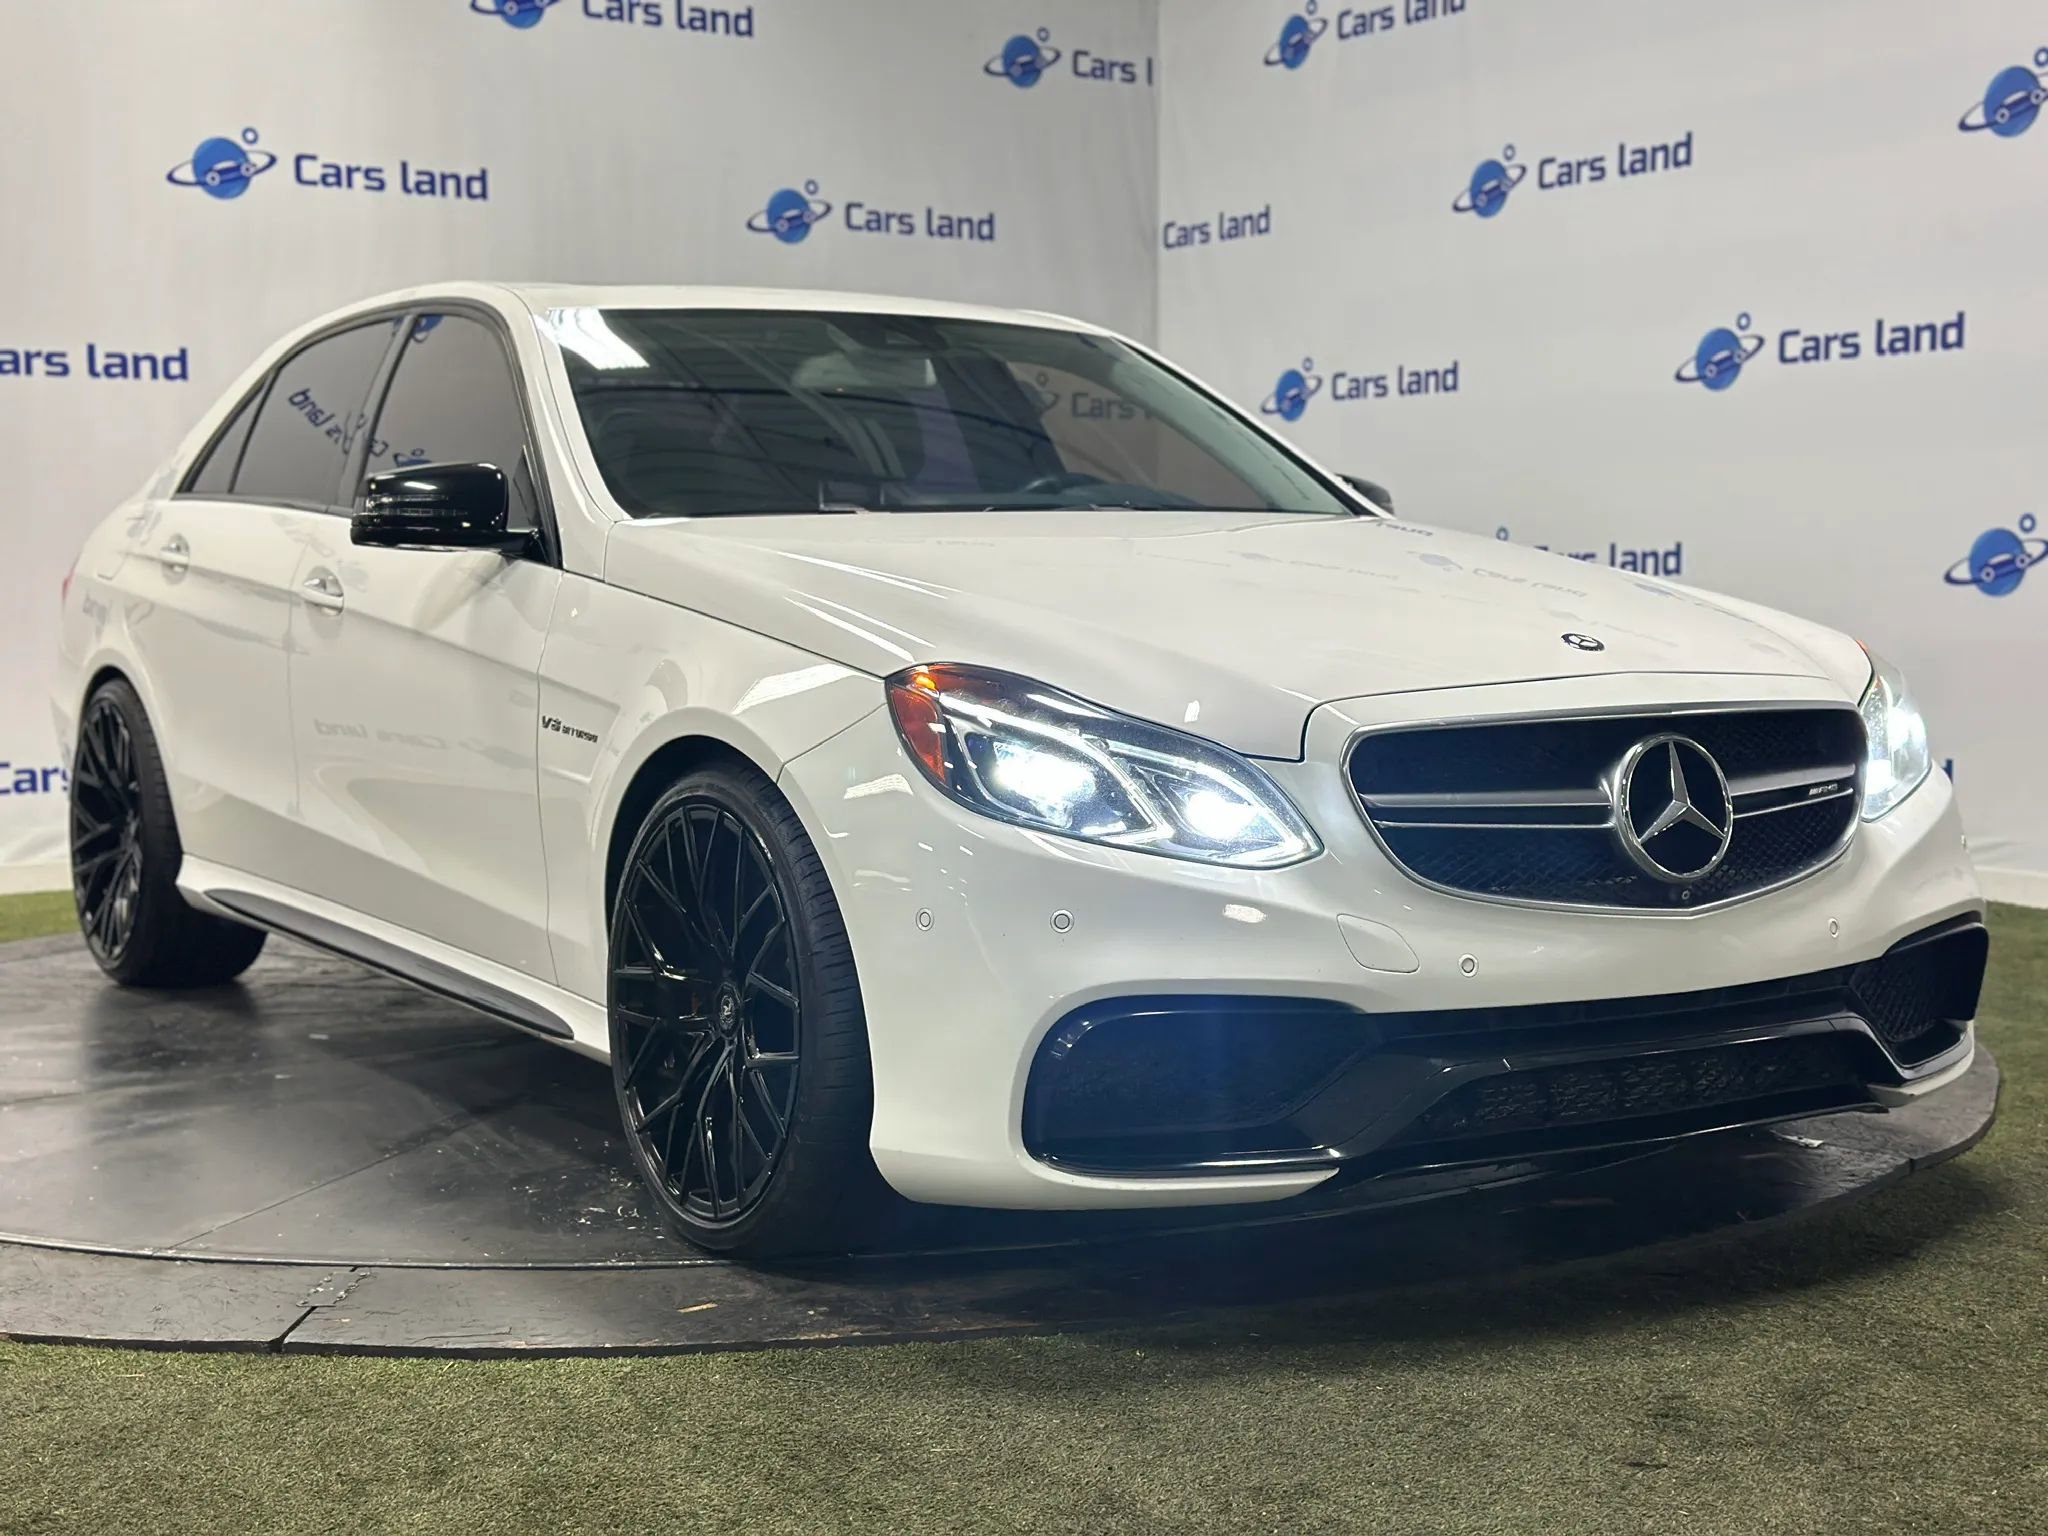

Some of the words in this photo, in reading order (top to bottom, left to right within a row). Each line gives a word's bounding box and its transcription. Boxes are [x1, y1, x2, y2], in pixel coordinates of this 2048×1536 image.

[582, 0, 663, 27] Cars
[676, 0, 754, 37] land
[1337, 5, 1395, 40] Cars
[1072, 49, 1137, 84] Cars
[294, 153, 387, 192] Cars
[400, 161, 489, 201] land
[1537, 155, 1607, 191] Cars
[1618, 131, 1693, 178] land
[844, 202, 916, 236] Cars
[926, 207, 995, 242] land
[1162, 219, 1211, 250] Cars
[1218, 204, 1271, 241] land
[1778, 329, 1861, 364] Cars
[1875, 312, 1965, 357] land
[0, 349, 70, 377] ars
[87, 343, 189, 381] land
[1331, 370, 1389, 401] Cars
[1397, 360, 1459, 397] land
[1071, 391, 1137, 420] Cars
[1609, 541, 1683, 577] land
[0, 762, 68, 794] ar
